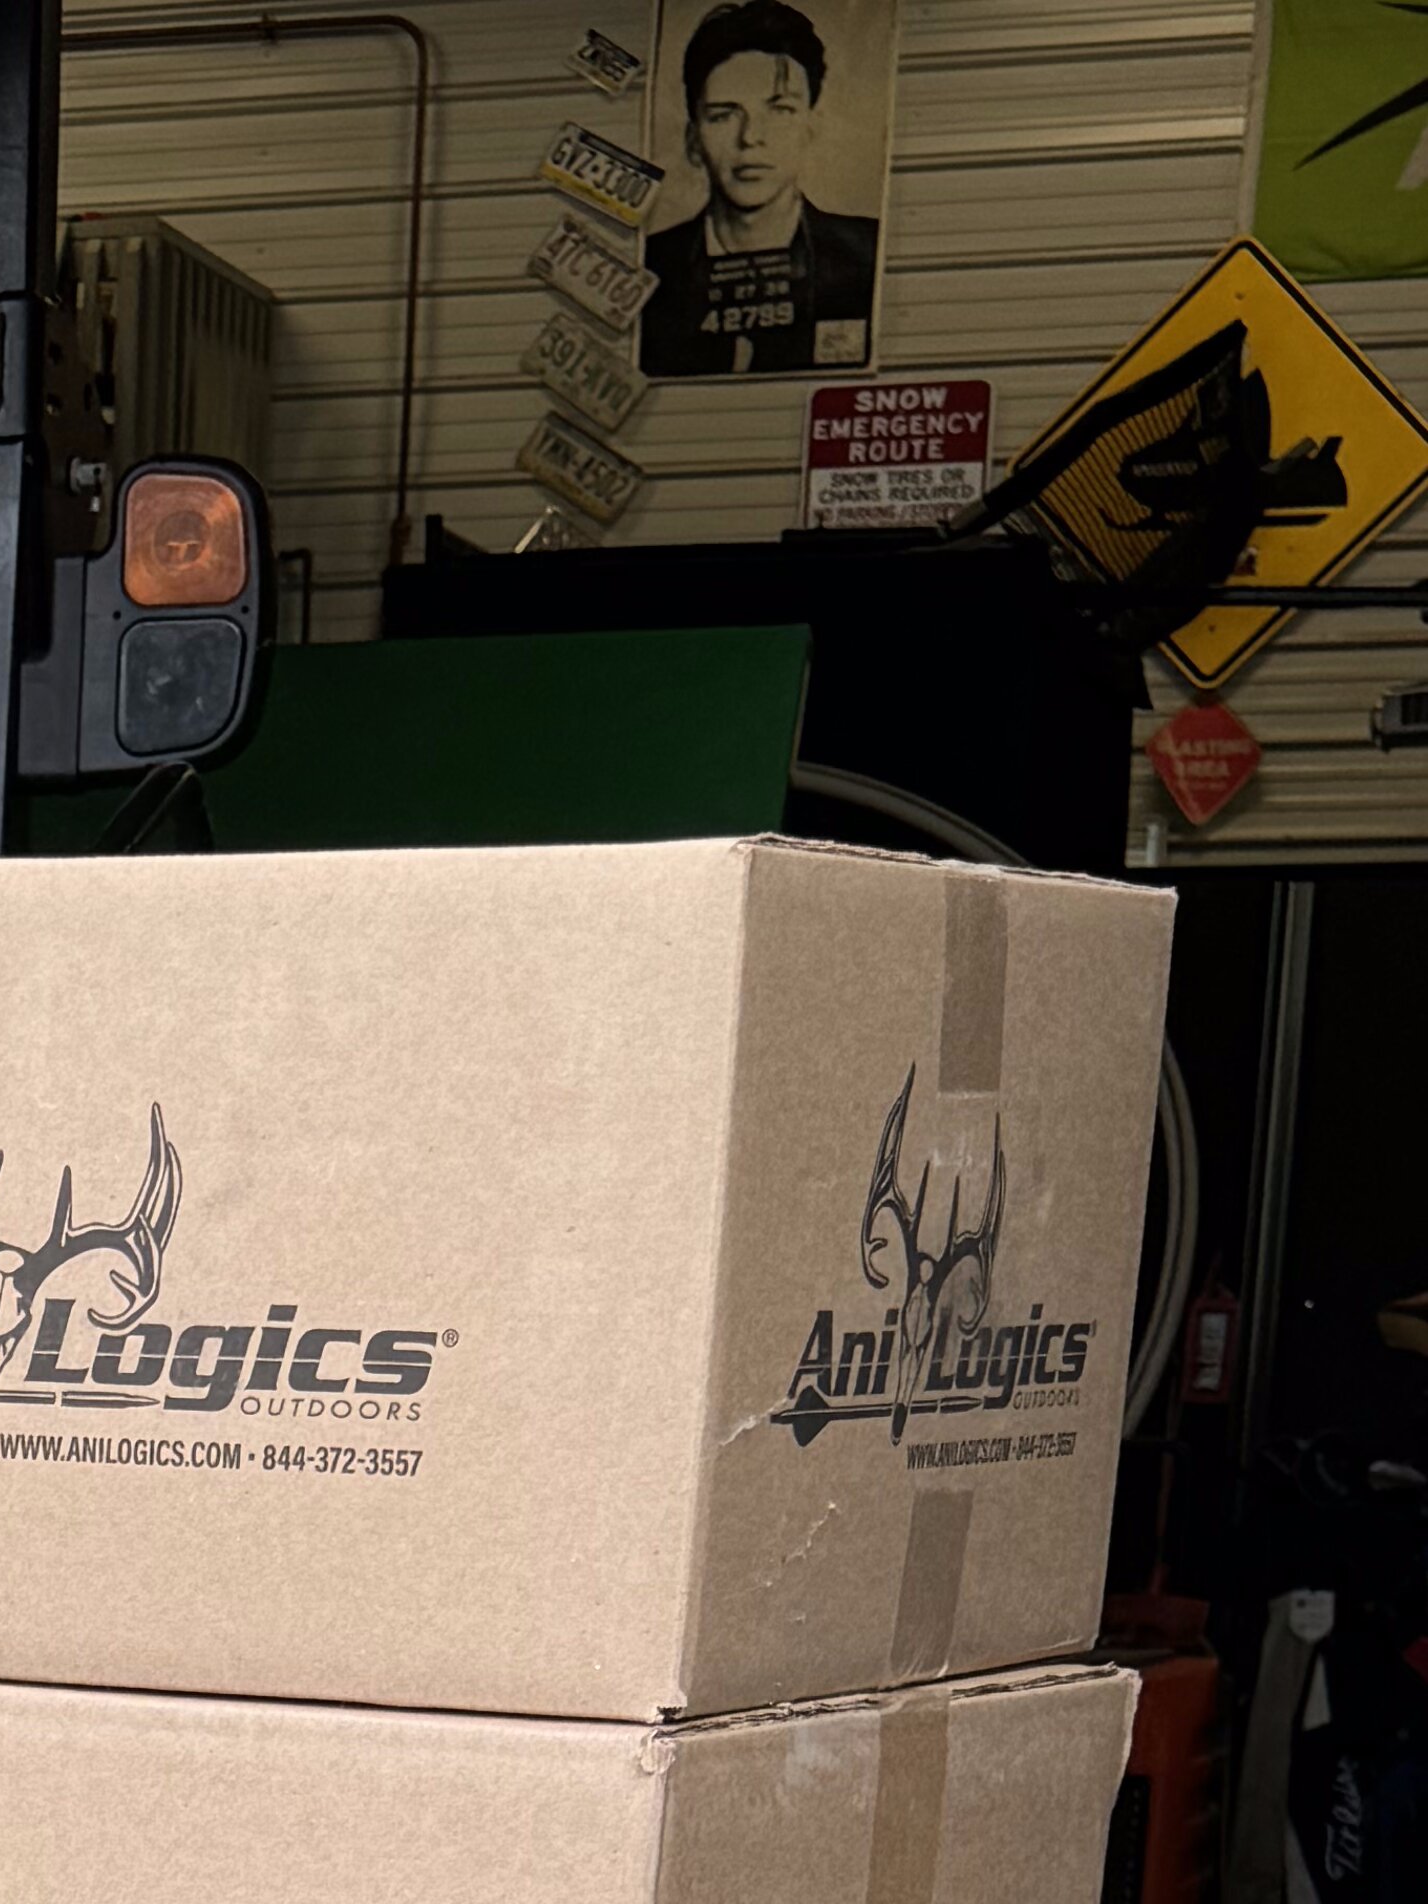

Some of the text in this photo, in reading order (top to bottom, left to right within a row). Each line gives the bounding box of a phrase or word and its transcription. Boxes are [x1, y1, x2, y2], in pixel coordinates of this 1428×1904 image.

[853, 385, 949, 414] SNOW
[812, 410, 986, 442] EMERGENCY
[848, 436, 946, 465] ROUTE
[830, 470, 879, 488] SNOW
[940, 467, 966, 483] OR
[818, 484, 975, 505] CHAINS REQUIRED
[787, 1307, 900, 1400] Ani
[239, 1394, 423, 1422] OUTDOORS
[260, 1444, 424, 1478] 844-372-3557
